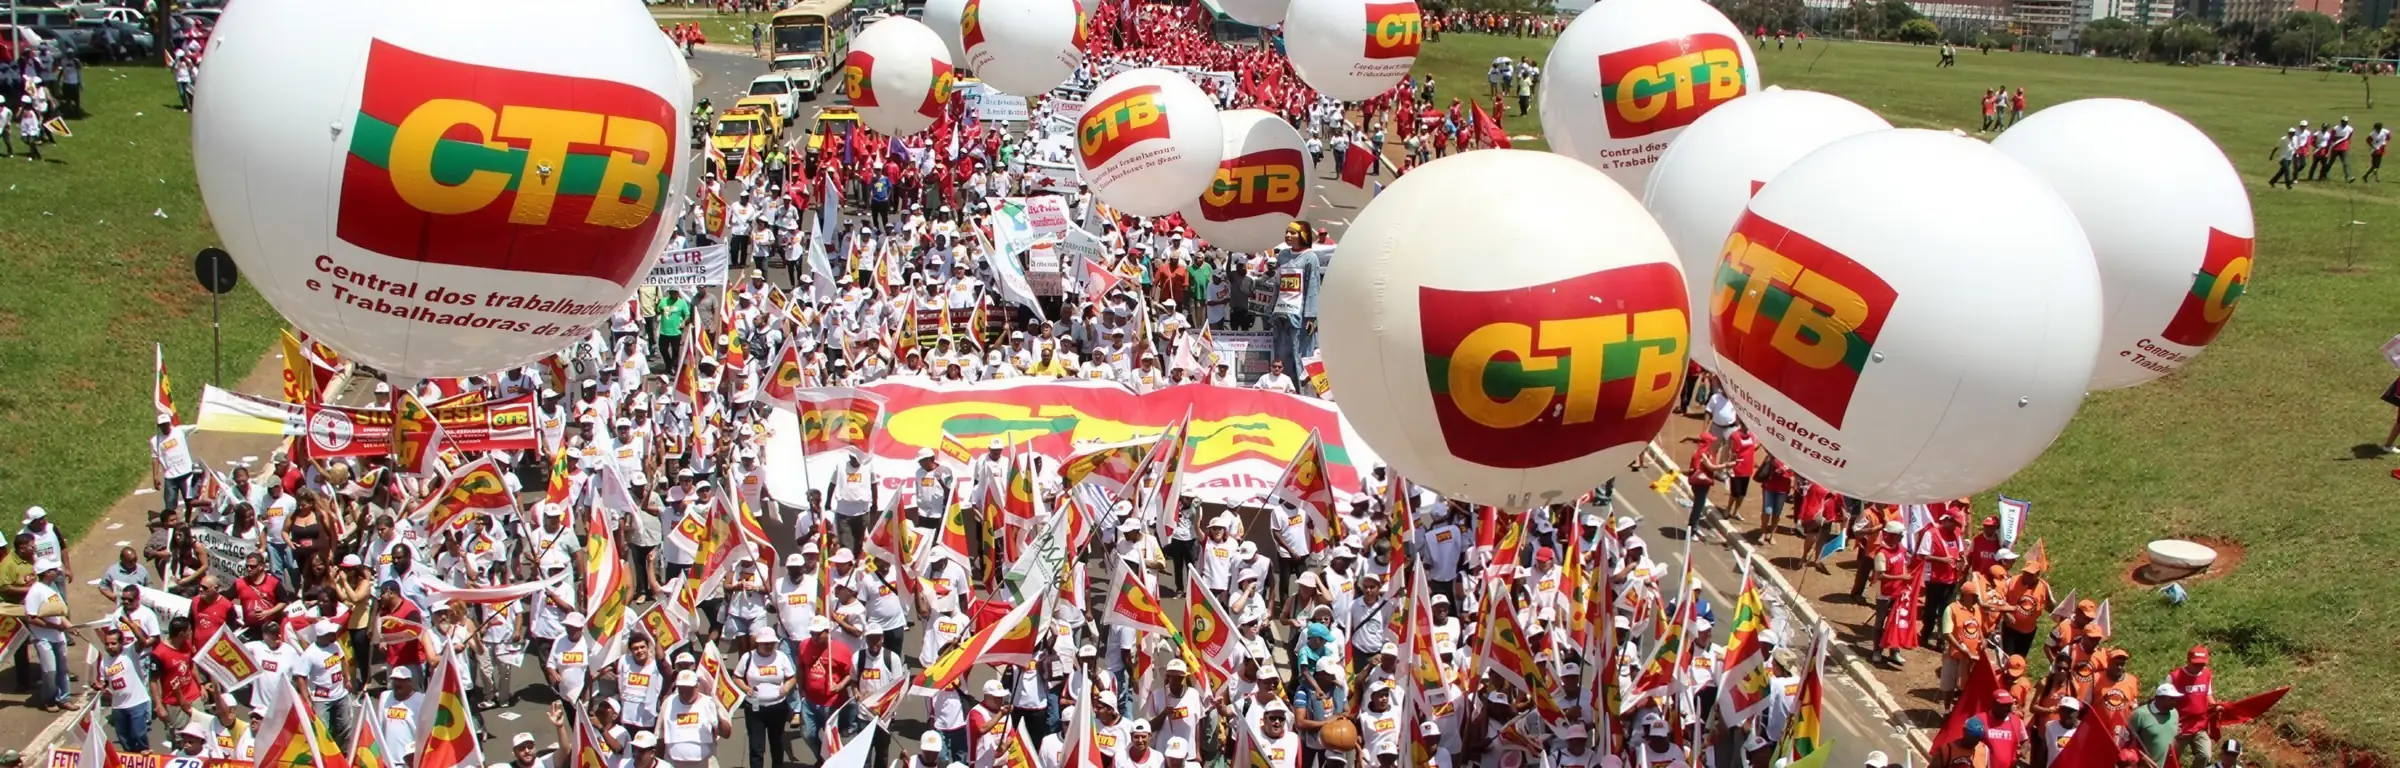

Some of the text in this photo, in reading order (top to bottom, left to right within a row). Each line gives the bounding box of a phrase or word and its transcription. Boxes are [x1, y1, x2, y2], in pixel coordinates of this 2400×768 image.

[1376, 13, 1421, 48] CT
[1616, 48, 1743, 123] CTB
[1081, 94, 1160, 156] CTB
[388, 98, 668, 229] CTB
[1203, 164, 1300, 207] CTB
[306, 278, 322, 291] e
[332, 284, 530, 333] Trabalhadoras
[532, 322, 561, 337] de
[315, 255, 418, 298] Central
[425, 286, 477, 306] dos
[1710, 232, 1868, 369] CTB
[1448, 308, 1688, 429] CTB
[801, 409, 868, 441] CTB
[1730, 379, 1841, 452] trabalhadores
[1766, 425, 1847, 469] de Brasil
[52, 750, 81, 768] FETR
